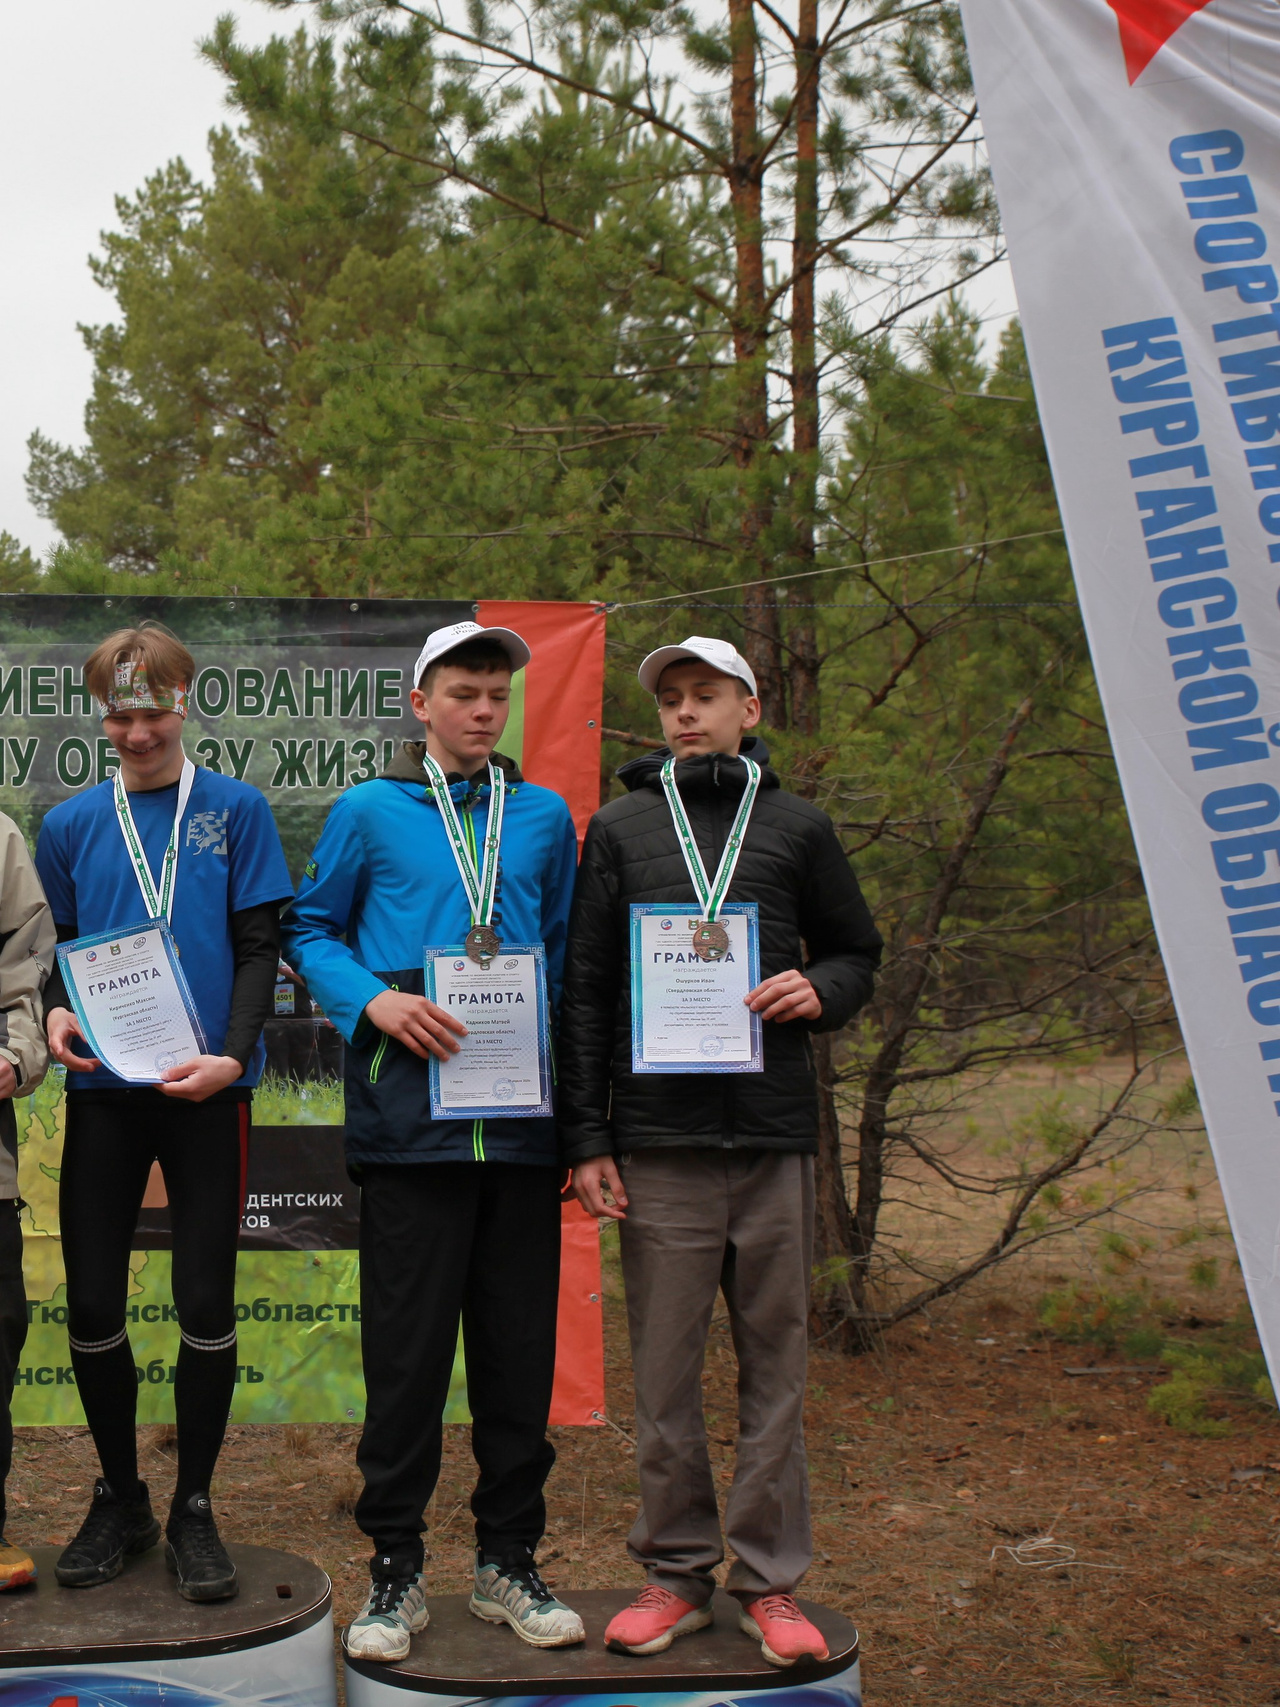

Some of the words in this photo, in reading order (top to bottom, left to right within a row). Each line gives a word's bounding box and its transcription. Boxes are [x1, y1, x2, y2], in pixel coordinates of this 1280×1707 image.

[1101, 316, 1280, 772] КУРГАНСКОЙ
[56, 737, 255, 788] ОБЗУ
[271, 738, 420, 788] ЖИЗ
[654, 952, 735, 963] ГРАМА
[88, 968, 161, 996] ГРАМОТА
[448, 992, 525, 1004] ГРАМОТА
